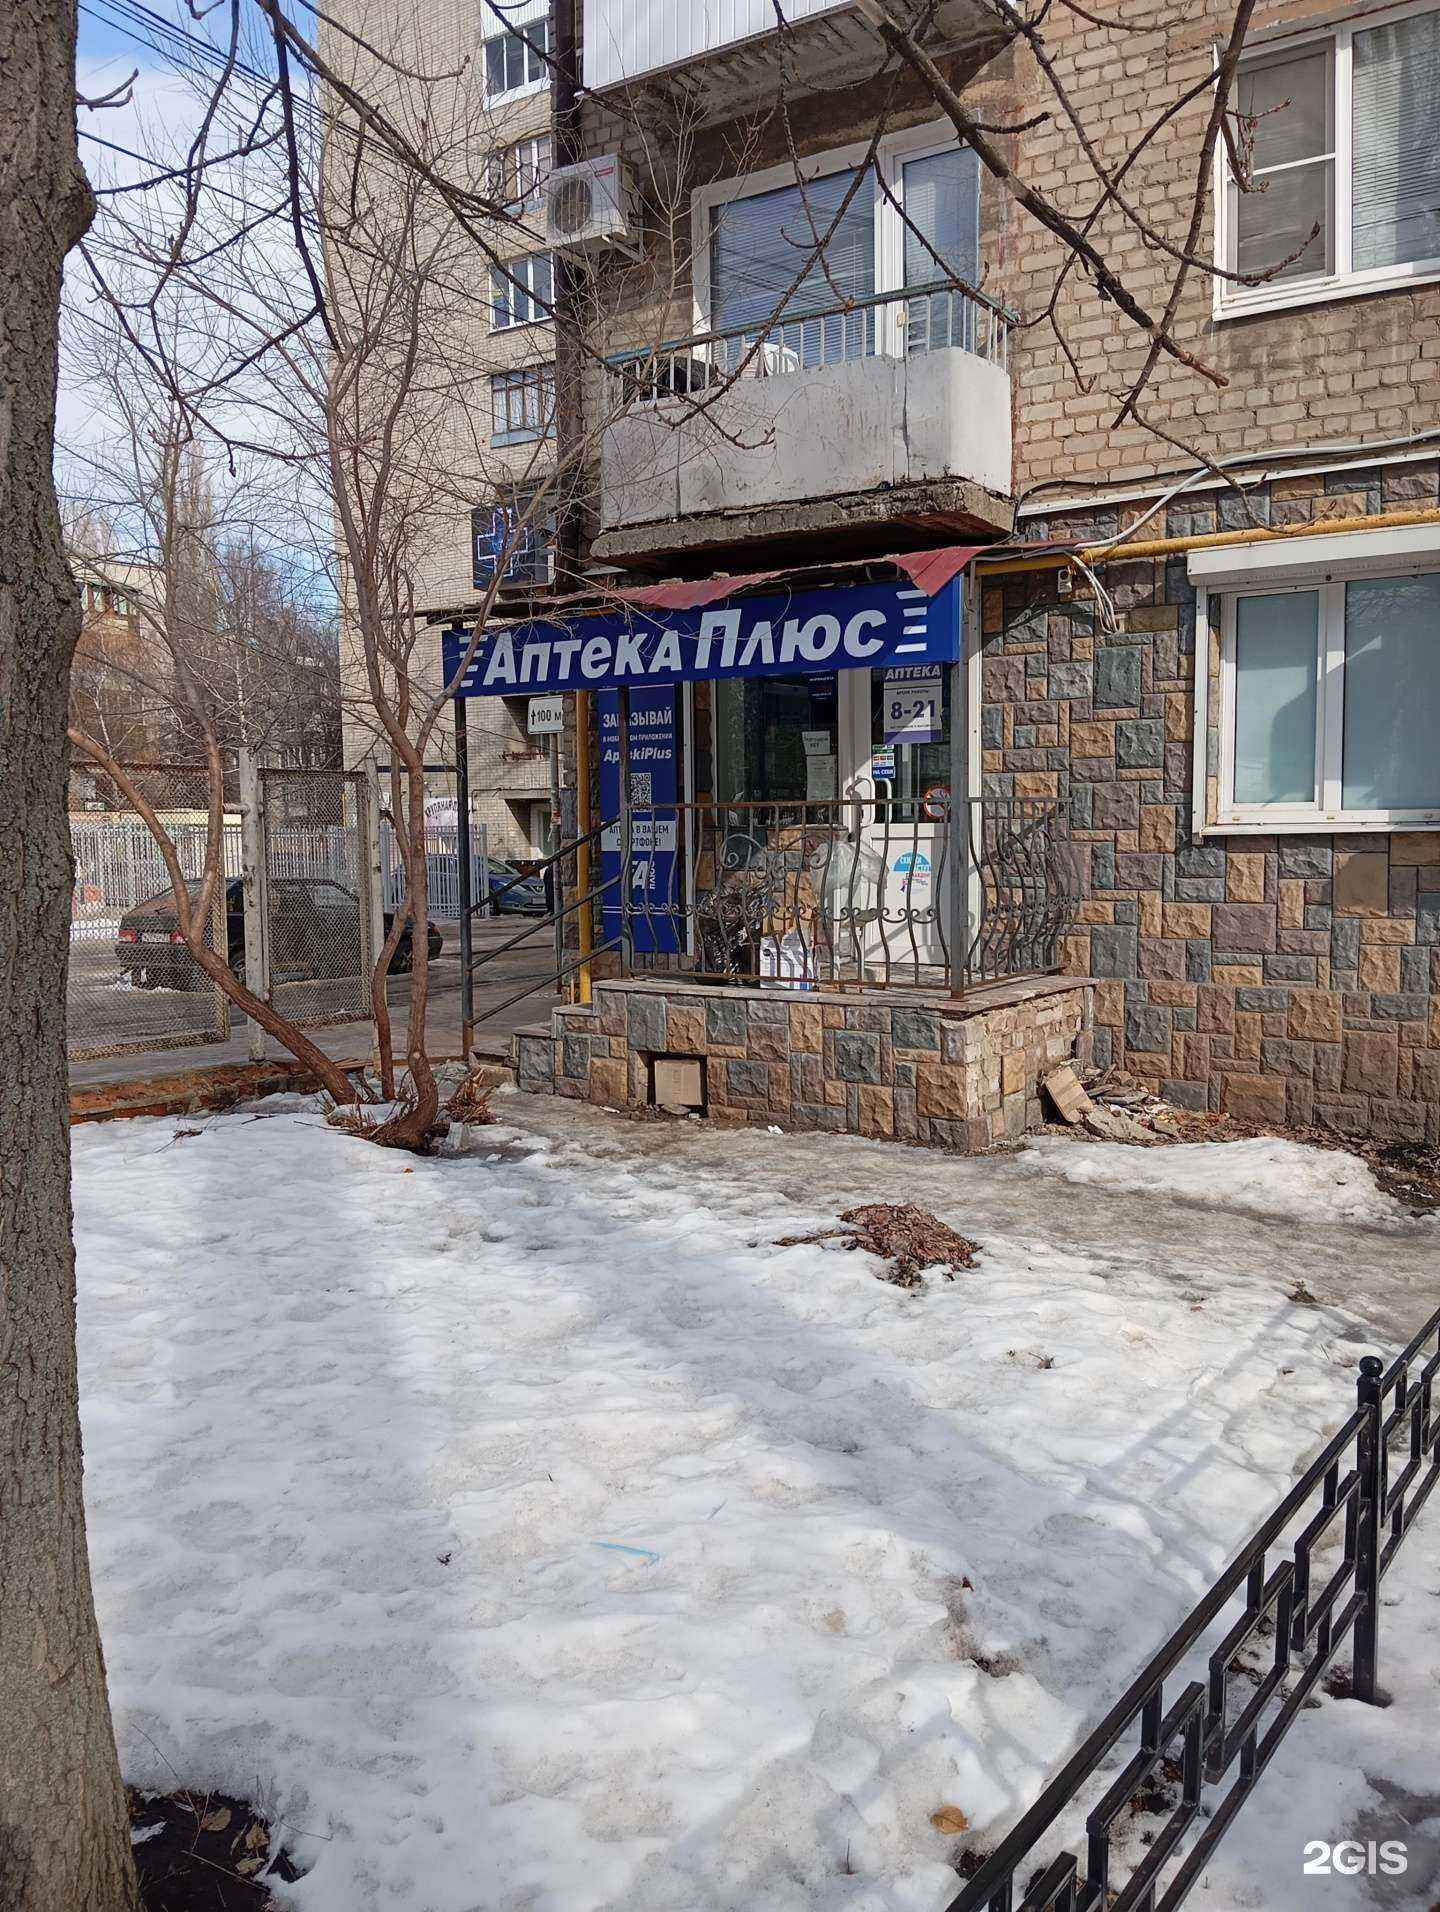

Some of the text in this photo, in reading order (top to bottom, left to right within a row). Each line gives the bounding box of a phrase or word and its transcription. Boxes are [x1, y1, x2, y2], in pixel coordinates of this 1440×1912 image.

[885, 664, 941, 680] АПТЕКА
[537, 709, 551, 722] 100
[602, 706, 672, 728] ЗАЗЫВАЙ
[890, 699, 936, 720] 8-21
[603, 746, 672, 764] ApkiPlus
[636, 825, 641, 833] В
[616, 837, 662, 847] СРТФОЕ!
